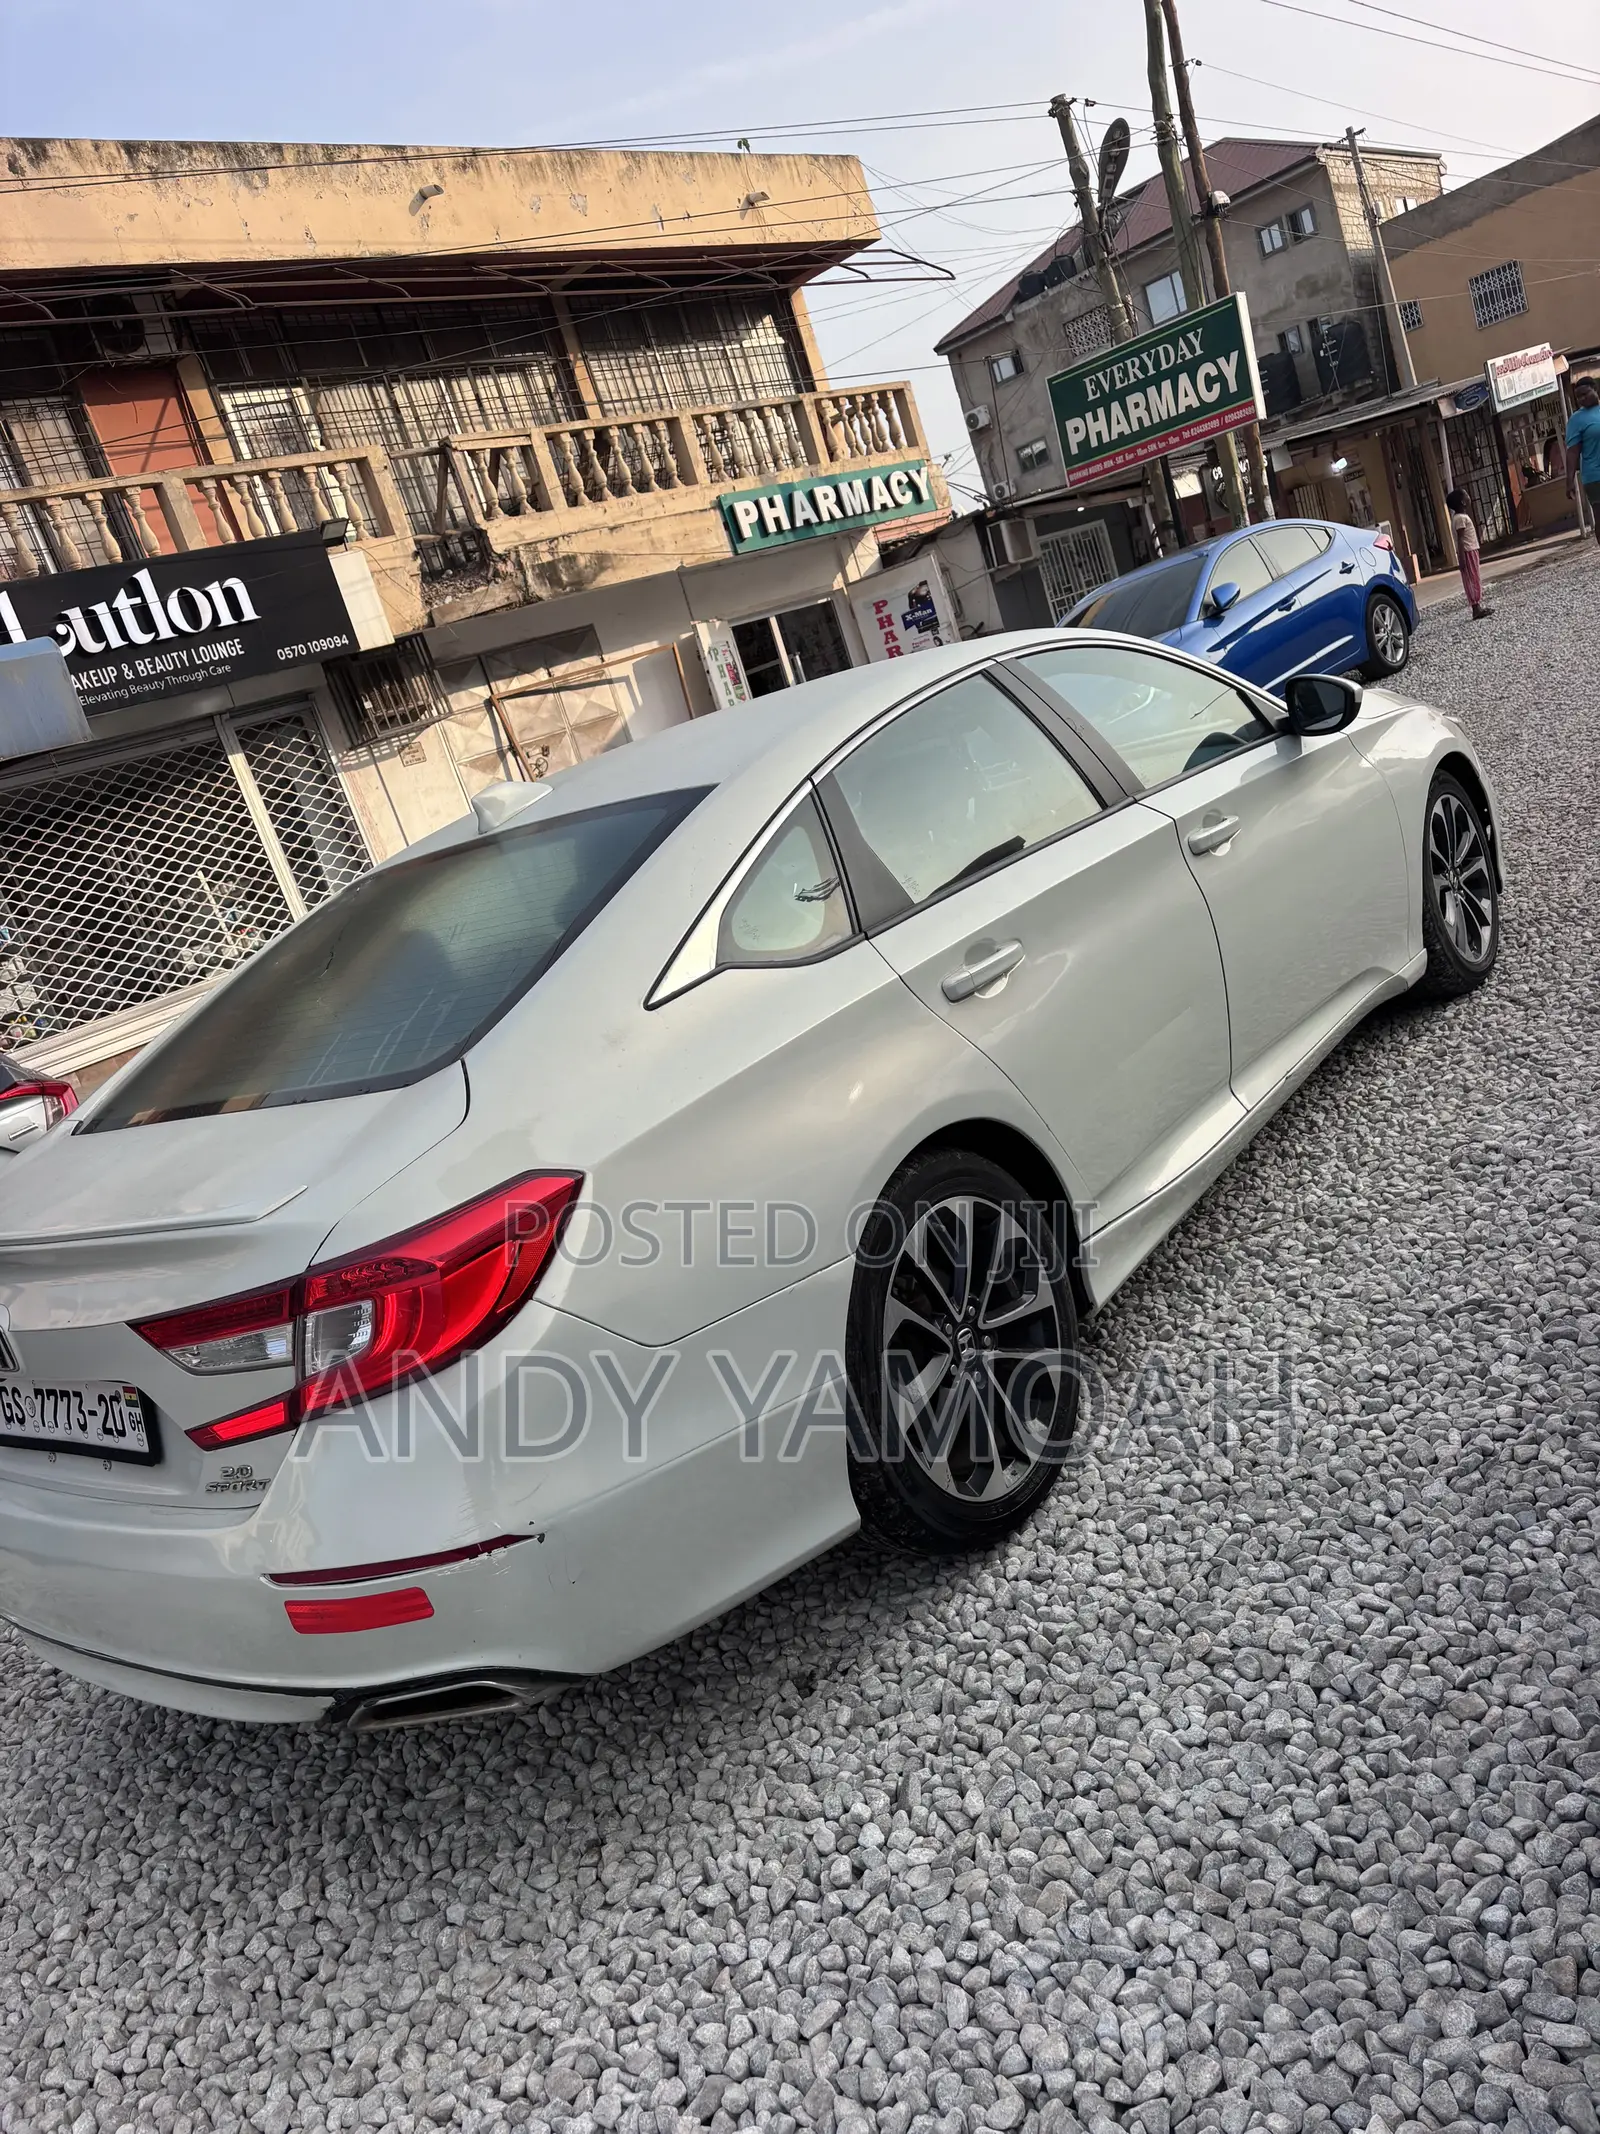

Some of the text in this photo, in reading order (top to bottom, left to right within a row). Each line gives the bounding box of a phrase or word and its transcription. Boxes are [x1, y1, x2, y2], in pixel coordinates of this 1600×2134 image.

[1083, 328, 1205, 402] EVERYDAY
[1065, 350, 1239, 456] PHARMACY
[733, 466, 932, 539] PHARMACY
[905, 607, 933, 621] X-Man
[70, 638, 246, 693] AKEUP & BEAUTY LOUNGE
[276, 633, 350, 661] 0570 109094
[78, 662, 232, 707] Elevating Beauty Through Care
[0, 1386, 27, 1425] GS
[128, 1411, 145, 1433] GH
[205, 1477, 272, 1493] SPORT
[220, 1464, 253, 1479] 2.0
